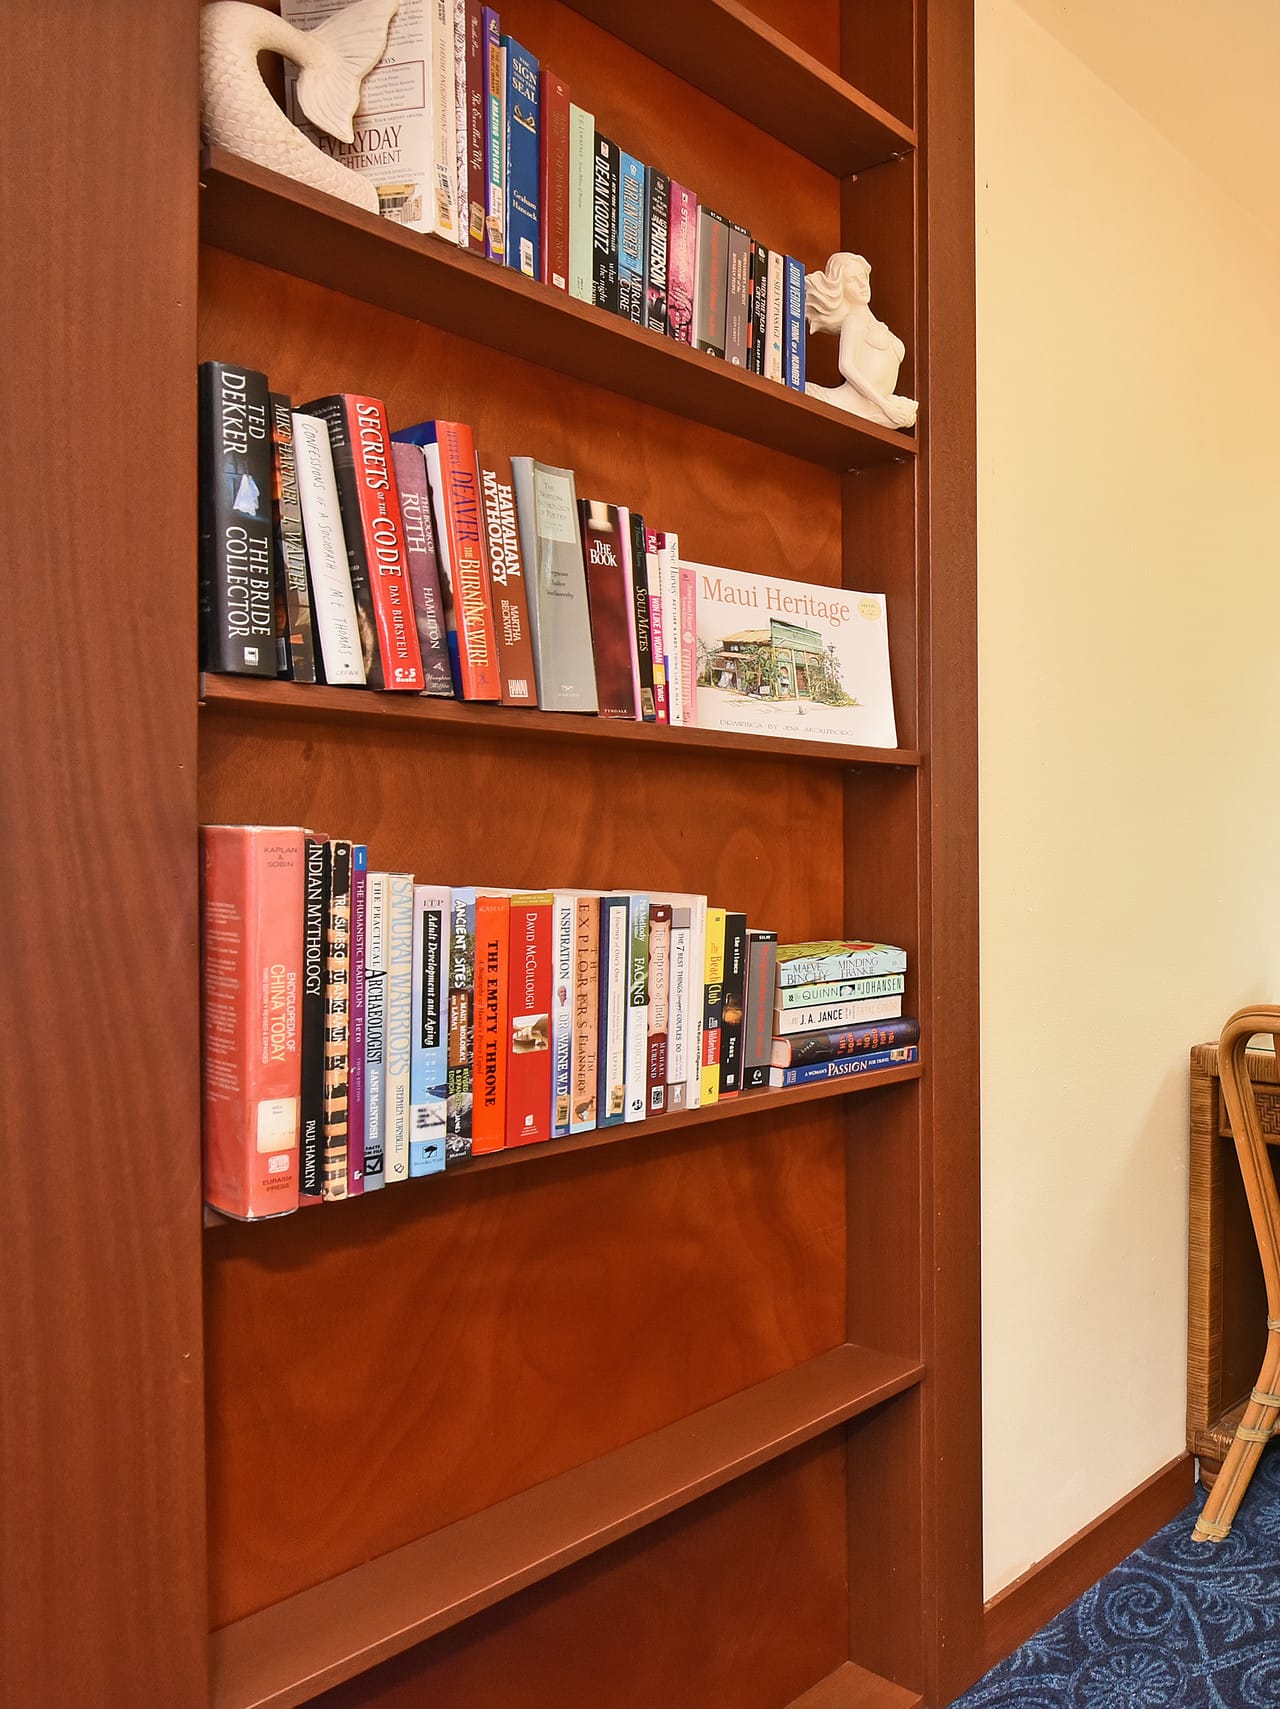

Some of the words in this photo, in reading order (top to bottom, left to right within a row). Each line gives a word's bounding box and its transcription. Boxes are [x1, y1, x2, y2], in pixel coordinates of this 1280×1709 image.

[511, 58, 537, 86] SIGN
[471, 88, 480, 109] The
[511, 76, 538, 105] SEAL
[471, 105, 482, 151] Excellent
[491, 96, 499, 138] AMAZING
[341, 150, 402, 170] GHTENMENT
[469, 144, 482, 174] Wife
[491, 136, 500, 185] EXPLORERS
[594, 153, 609, 200] DEAN
[513, 189, 537, 211] Graham
[513, 199, 538, 222] Hancock
[623, 172, 639, 223] HARLAN
[593, 193, 609, 257] KOONTZ
[622, 214, 639, 261] COBEN
[599, 262, 608, 281] the
[607, 259, 616, 286] what
[650, 219, 666, 292] PATTERSON
[596, 276, 607, 306] night
[789, 262, 800, 288] JOHN
[620, 275, 630, 315] CURE
[630, 271, 641, 328] MIRACLE
[789, 283, 800, 319] VERDON
[791, 317, 799, 343] THINK
[791, 352, 799, 387] NUMBER
[220, 370, 247, 456] DEKKER
[247, 403, 265, 439] TED
[273, 404, 292, 438] MIKE
[354, 402, 391, 492] SECRETS
[276, 442, 297, 505] HARTNER
[375, 490, 385, 502] OF
[377, 500, 388, 516] THE
[419, 494, 430, 515] THE
[448, 469, 480, 543] DEAVER
[400, 492, 426, 554] RUTH
[481, 469, 508, 586] MYTHOLOGY
[496, 483, 521, 577] HAWAIIAN
[248, 533, 269, 576] THE
[283, 531, 305, 592] WALTER
[370, 516, 403, 578] CODE
[462, 545, 474, 559] THE
[590, 548, 618, 568] BOOK
[593, 539, 612, 557] THE
[647, 534, 657, 554] PLAY
[225, 525, 250, 639] COLLECTOR
[387, 583, 402, 607] DAN
[456, 558, 487, 626] BURNING
[249, 579, 271, 635] BRIDE
[422, 588, 440, 648] HAMILTON
[651, 610, 661, 627] LIKE
[702, 575, 759, 608] Maui
[765, 586, 851, 628] Heritage
[390, 609, 409, 658] BURSTEIN
[499, 600, 513, 645] BECKWITH
[508, 605, 522, 641] MARTHA
[464, 629, 490, 667] WIRE
[653, 632, 663, 664] WOMAN
[263, 846, 298, 855] KAPLAN
[267, 860, 294, 868] SOBIN
[306, 841, 323, 901] INDIAN
[355, 879, 364, 898] THE
[372, 879, 382, 903] THE
[333, 892, 347, 950] TREASURES
[355, 899, 364, 956] HUMANISTIC
[370, 904, 382, 967] PRACTICAL
[390, 879, 413, 969] SAMURAI
[427, 913, 438, 940] Adult
[453, 899, 468, 956] ANCIENT
[524, 912, 537, 942] DAVID
[636, 911, 646, 941] Mellody
[654, 928, 666, 941] The
[304, 902, 322, 997] MYTHOLOGY
[486, 939, 499, 976] THE
[558, 906, 571, 980] INSPIRATION
[732, 947, 740, 974] silence
[423, 941, 438, 998] Development
[453, 956, 467, 989] SITES
[524, 943, 537, 1010] McCULLOUGH
[575, 903, 590, 1030] EXPLORERS
[588, 945, 597, 983] THE
[633, 956, 644, 1005] FACING
[653, 945, 666, 990] Empress
[709, 955, 722, 982] Beach
[787, 971, 829, 985] BINCHY
[792, 963, 821, 974] MAEVE
[838, 956, 879, 969] MINDING
[841, 967, 875, 979] FRANKIE
[270, 963, 285, 1010] CHINA
[354, 959, 364, 1008] TRADITION
[707, 983, 721, 1005] Club
[802, 988, 839, 1001] QUINN
[861, 977, 902, 995] JOHANSEN
[285, 972, 296, 1037] ENCYCLOPEDIA
[332, 967, 345, 1048] TUTANKHAMUN
[365, 968, 387, 1065] ARCHAEOLOGIST
[426, 997, 436, 1012] and
[485, 978, 498, 1035] EMPTY
[654, 1002, 665, 1028] India
[817, 1009, 843, 1023] JANCE
[269, 1013, 286, 1060] TODAY
[354, 1016, 363, 1043] Fiero
[387, 972, 412, 1078] WARRIORS
[423, 1015, 437, 1046] Aging
[847, 1032, 855, 1054] BOOK
[286, 1038, 295, 1051] OF
[557, 1031, 568, 1071] WAYNE
[586, 1051, 595, 1073] TIM
[650, 1042, 658, 1079] KURLAND
[658, 1041, 666, 1078] MICHAEL
[675, 1041, 681, 1052] DO
[707, 1029, 717, 1065] Hilderbrand
[368, 1068, 379, 1093] JANE
[484, 1039, 497, 1107] THRONE
[556, 1070, 567, 1085] W.
[576, 1034, 588, 1095] FLANNERY
[828, 1060, 869, 1077] PASSION
[368, 1093, 379, 1140] McINTOSH
[394, 1083, 405, 1116] STEPHEN
[303, 1117, 317, 1145] PAUL
[394, 1116, 404, 1153] TURNBULL
[261, 1174, 293, 1186] EURASIA
[302, 1142, 316, 1190] HAMLYN
[266, 1183, 290, 1194] PRESS
